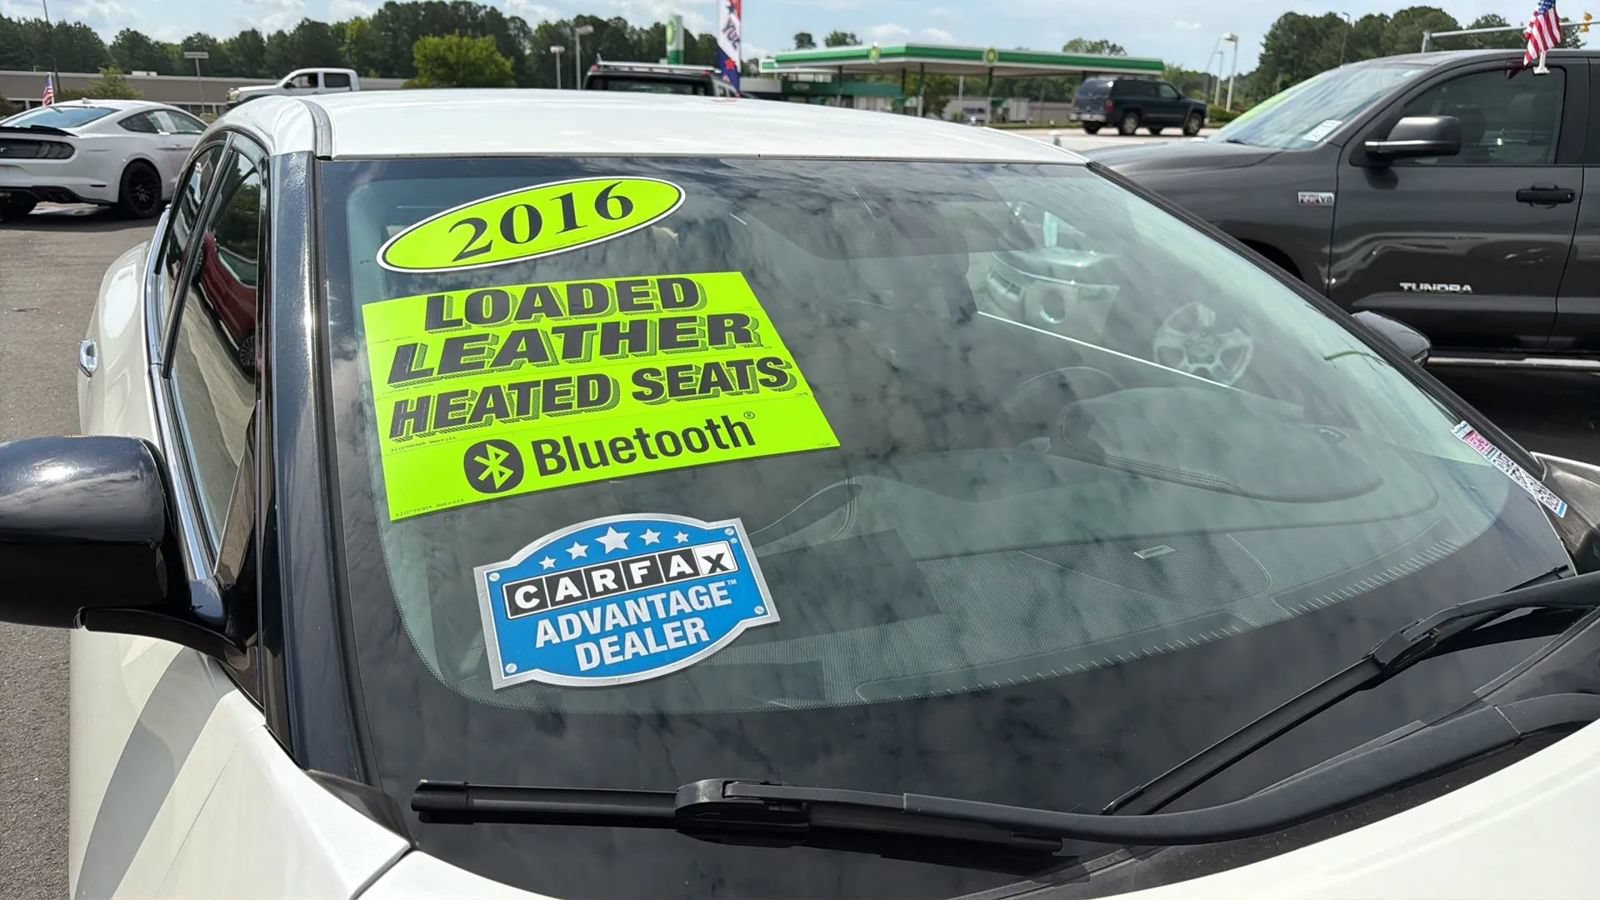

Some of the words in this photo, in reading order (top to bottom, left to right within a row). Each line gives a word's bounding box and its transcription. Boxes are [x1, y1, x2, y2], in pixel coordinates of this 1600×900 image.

[448, 181, 634, 262] 2016
[425, 277, 705, 334] LOADED
[1400, 282, 1473, 292] TUNDRA
[387, 312, 760, 388] LEATHER
[388, 373, 619, 441] HEATED
[632, 356, 797, 405] SEATS
[514, 552, 736, 610] CARFAX
[575, 617, 710, 672] DEALER
